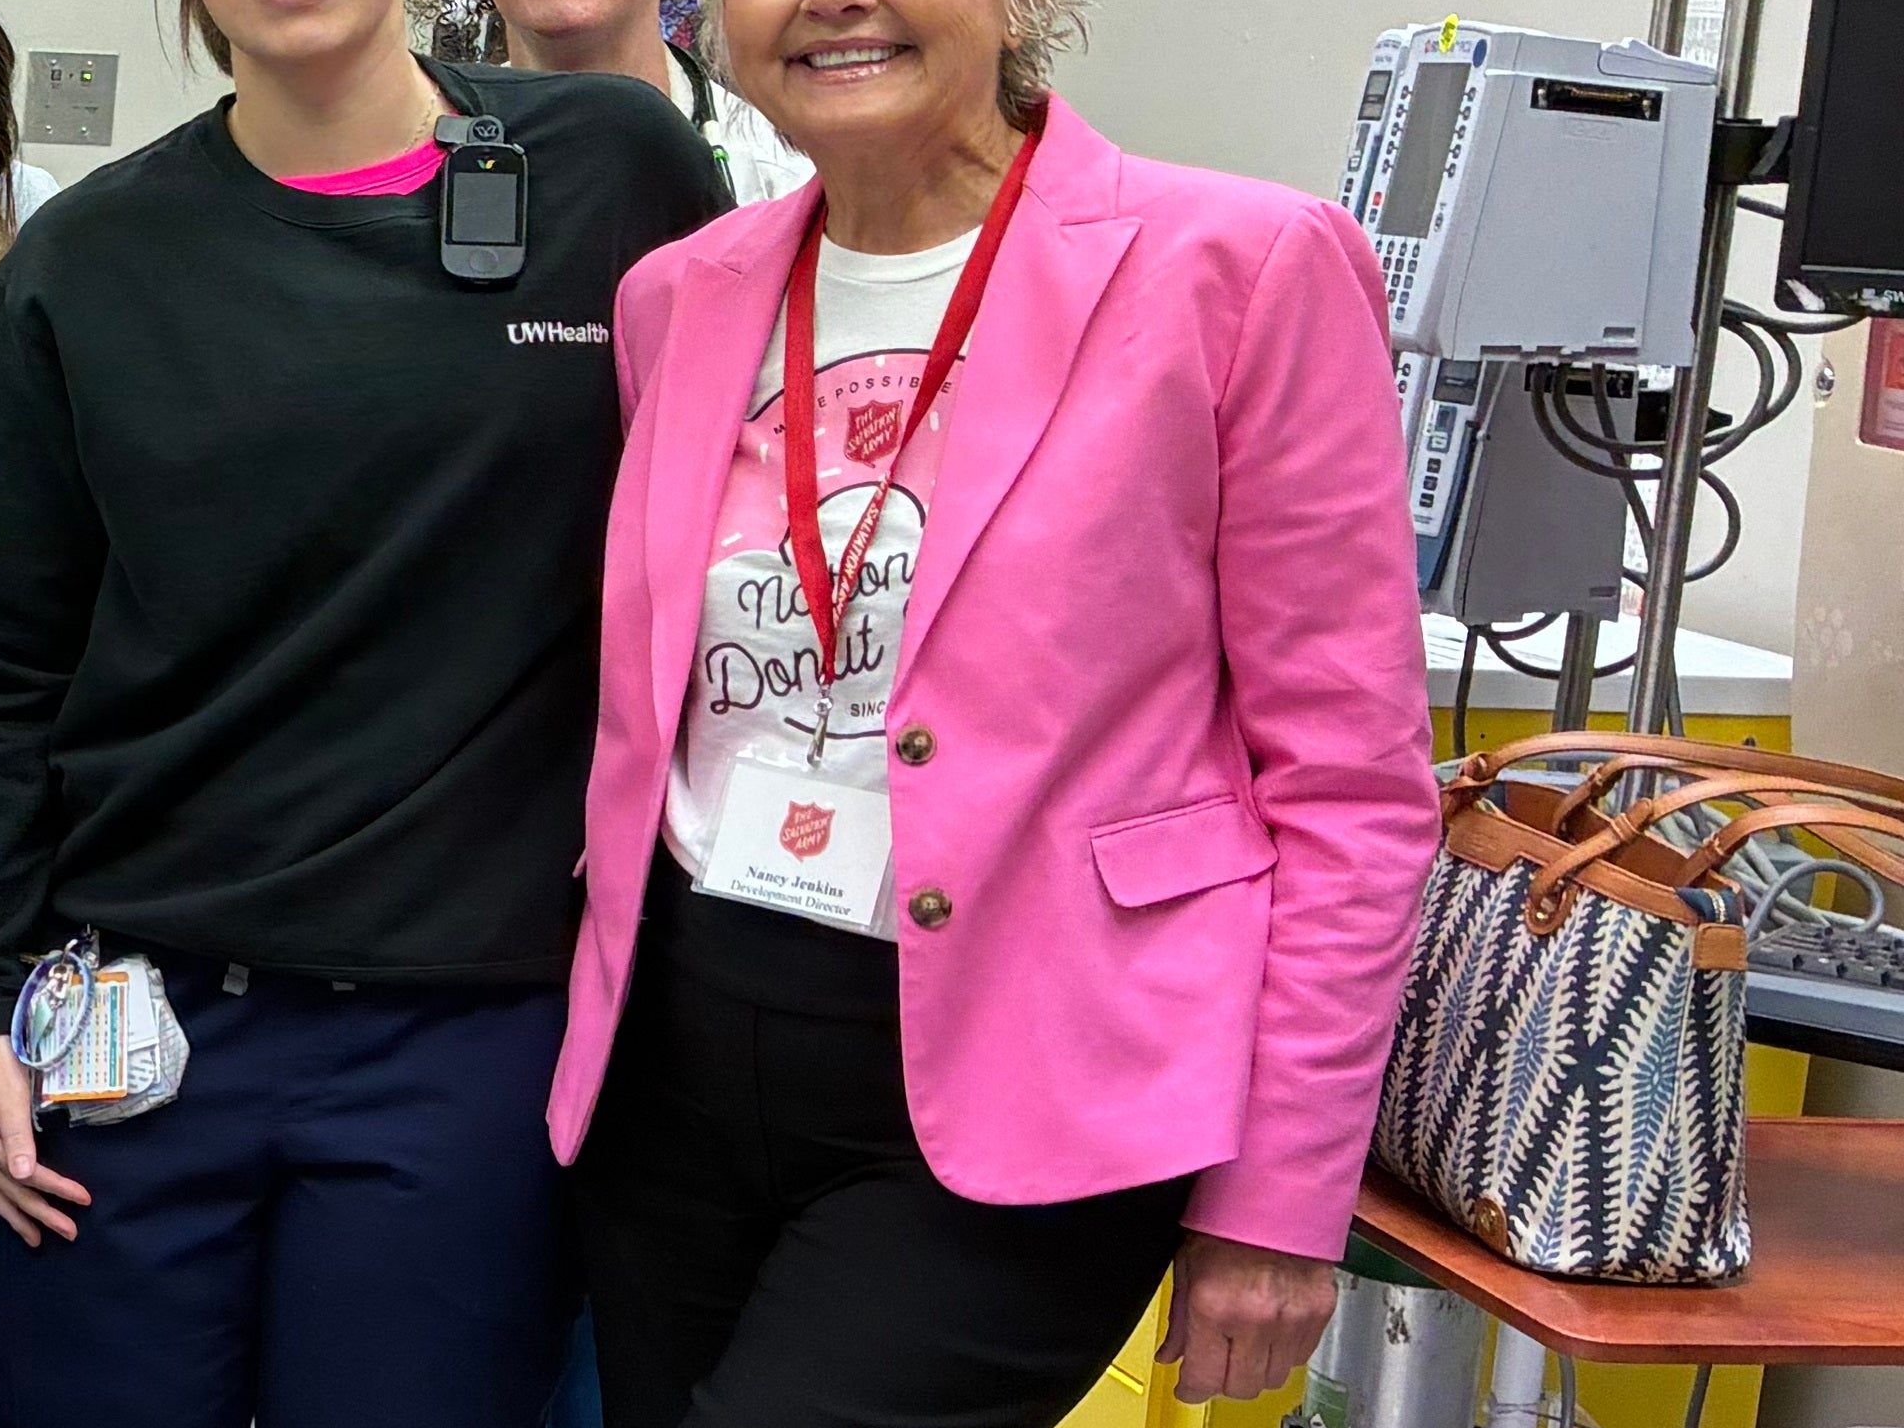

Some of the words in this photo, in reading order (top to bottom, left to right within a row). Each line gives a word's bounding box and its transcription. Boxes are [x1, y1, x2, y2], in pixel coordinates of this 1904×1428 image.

[506, 320, 610, 345] UWHealth
[834, 373, 953, 401] POSSIBE
[839, 503, 880, 582] SALVATION
[850, 699, 887, 718] SINC
[730, 879, 803, 906] Development
[804, 896, 852, 916] Director
[745, 865, 790, 888] Nancy
[791, 875, 845, 899] Jenkins
